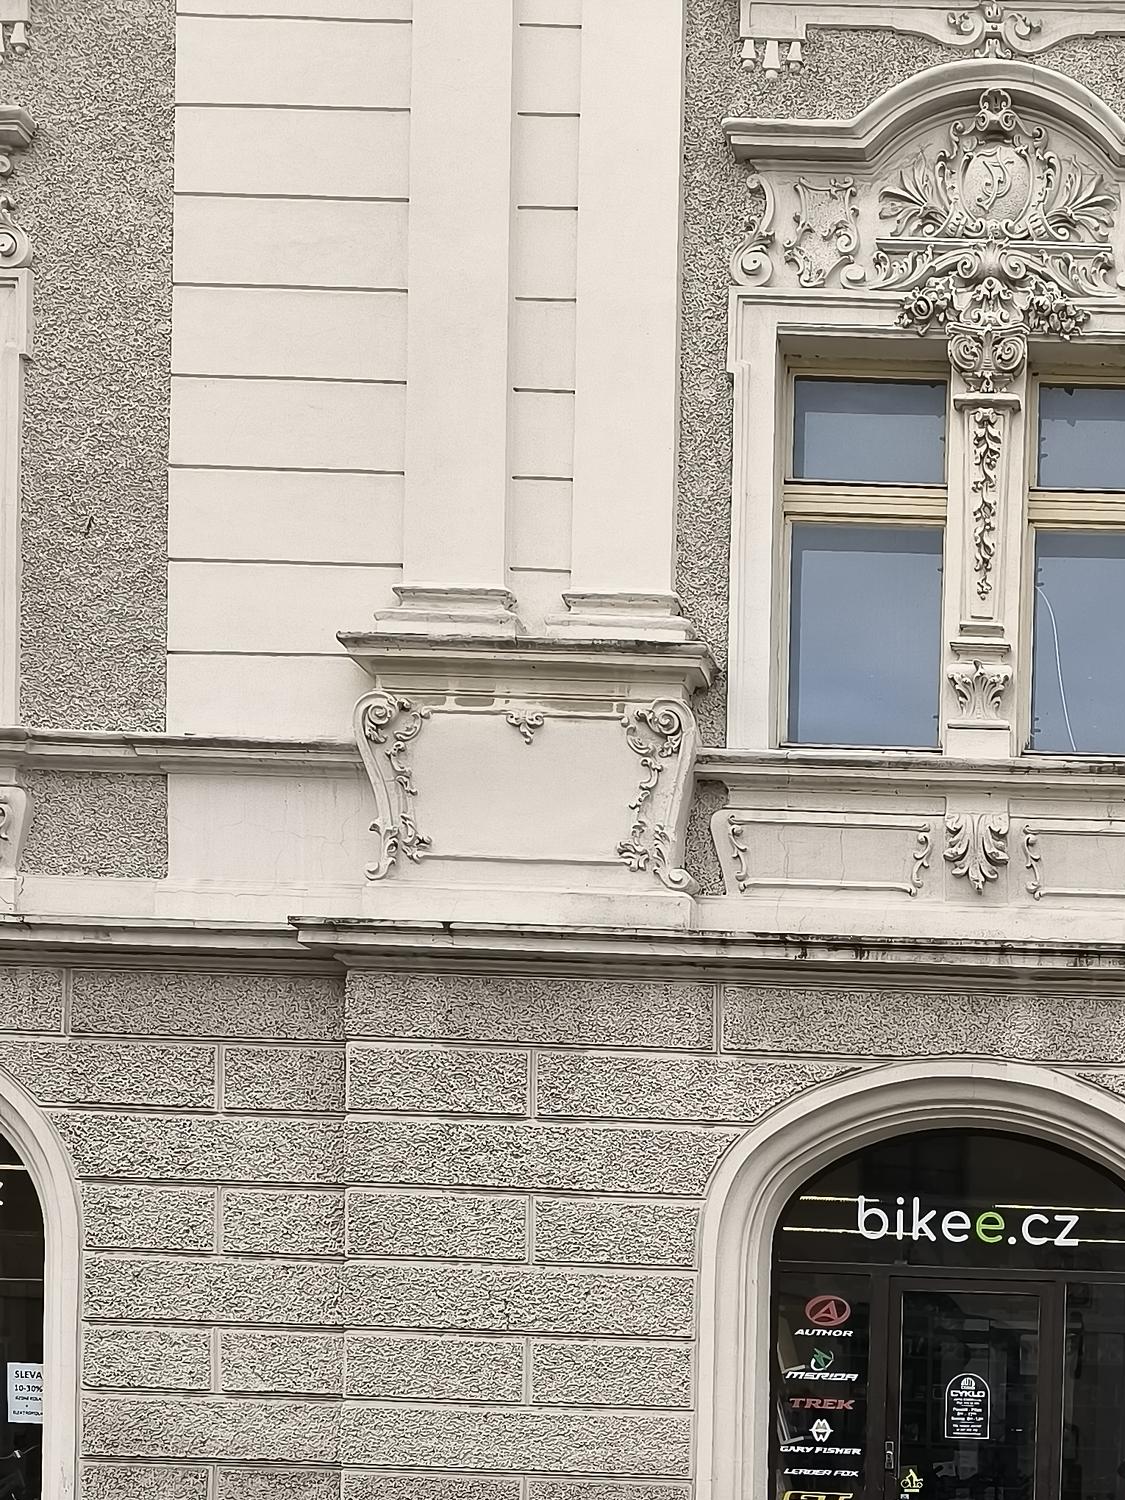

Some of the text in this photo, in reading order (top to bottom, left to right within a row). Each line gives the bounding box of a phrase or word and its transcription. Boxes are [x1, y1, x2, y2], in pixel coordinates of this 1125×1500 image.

[857, 1195, 1080, 1247] bikee.cz
[794, 1328, 854, 1337] AUTHOR
[14, 1370, 43, 1380] SLEVA
[785, 1371, 859, 1381] MERIDA
[14, 1384, 43, 1392] 10-30%
[789, 1398, 855, 1410] TREK
[814, 1446, 862, 1455] FISHER
[833, 1470, 859, 1478] FOX
